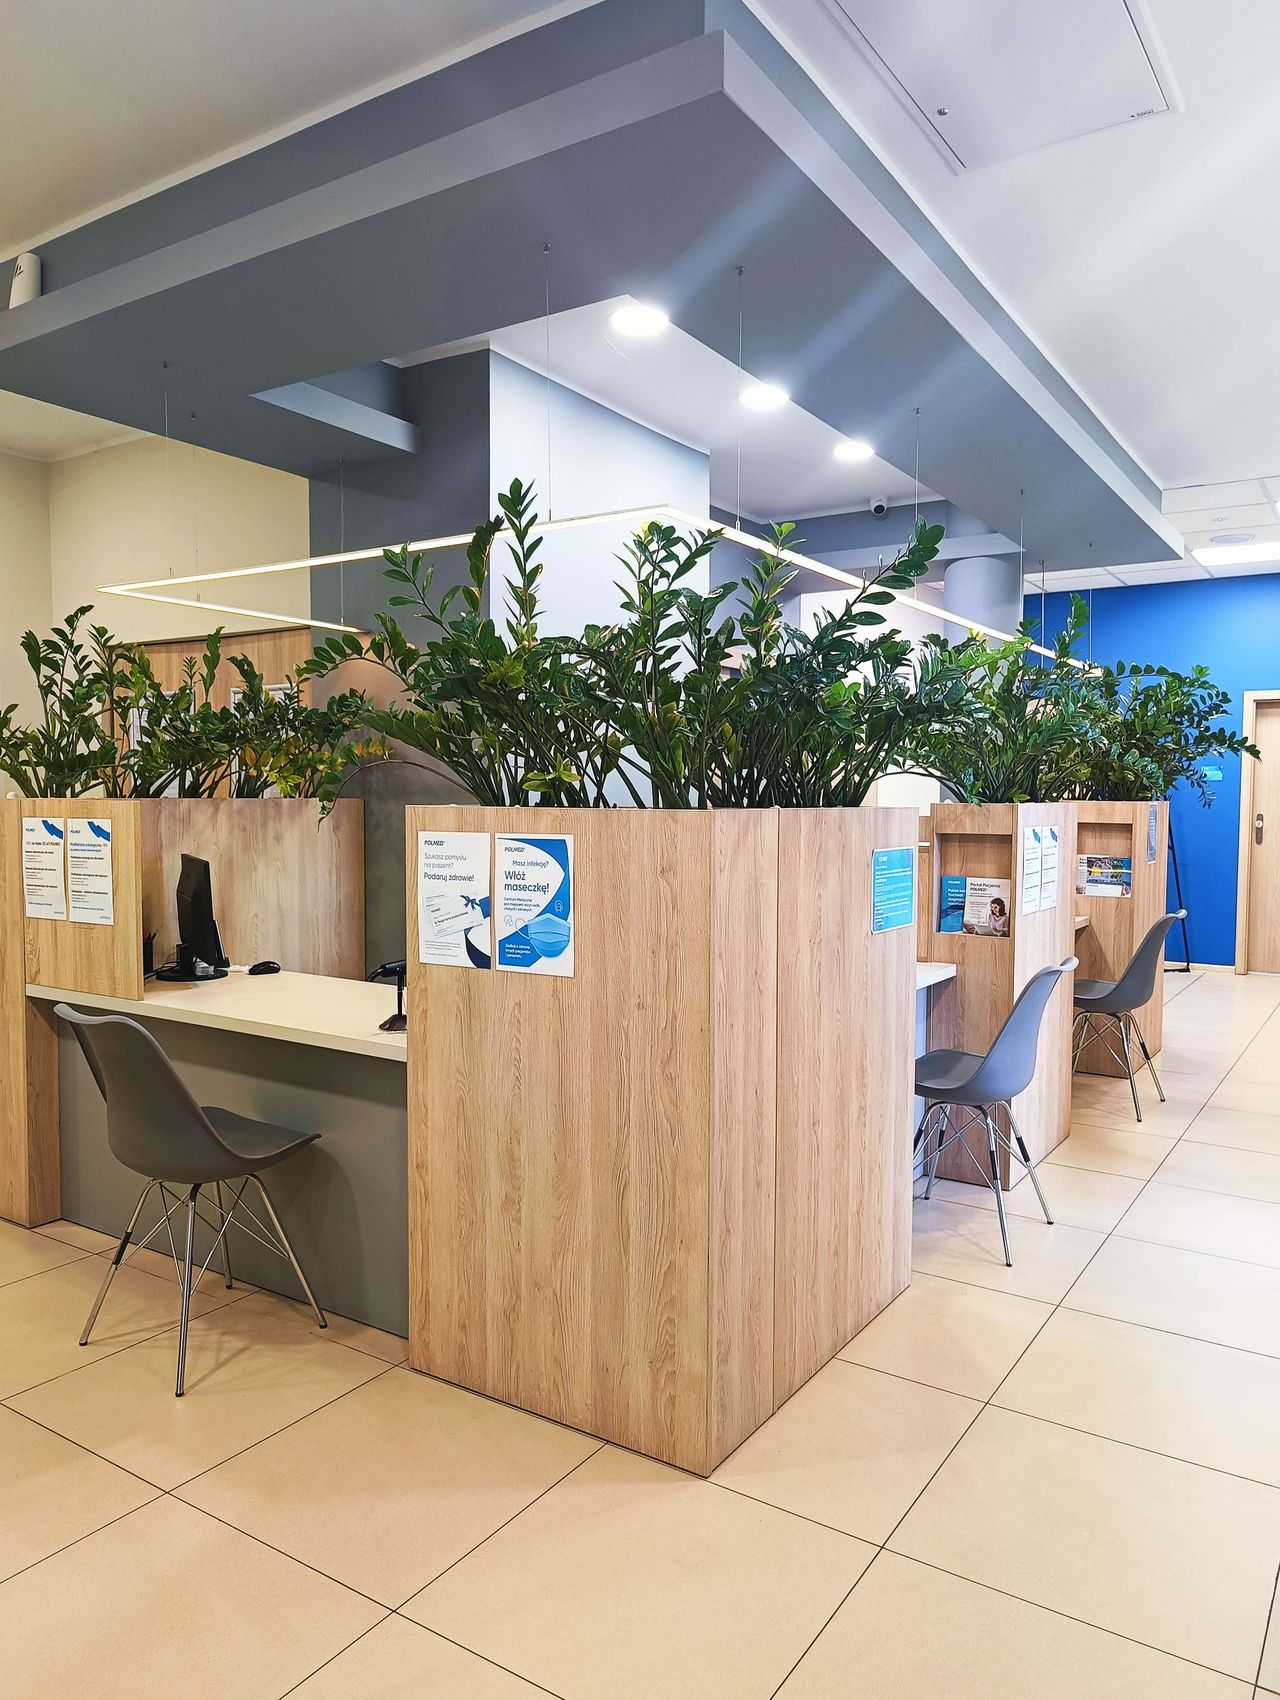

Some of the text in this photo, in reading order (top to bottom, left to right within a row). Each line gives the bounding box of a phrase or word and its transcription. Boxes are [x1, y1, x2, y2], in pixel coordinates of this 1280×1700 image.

[424, 872, 474, 882] Podaruj zdrowie!
[504, 870, 526, 880] Włóż
[504, 883, 550, 894] maseczkę!
